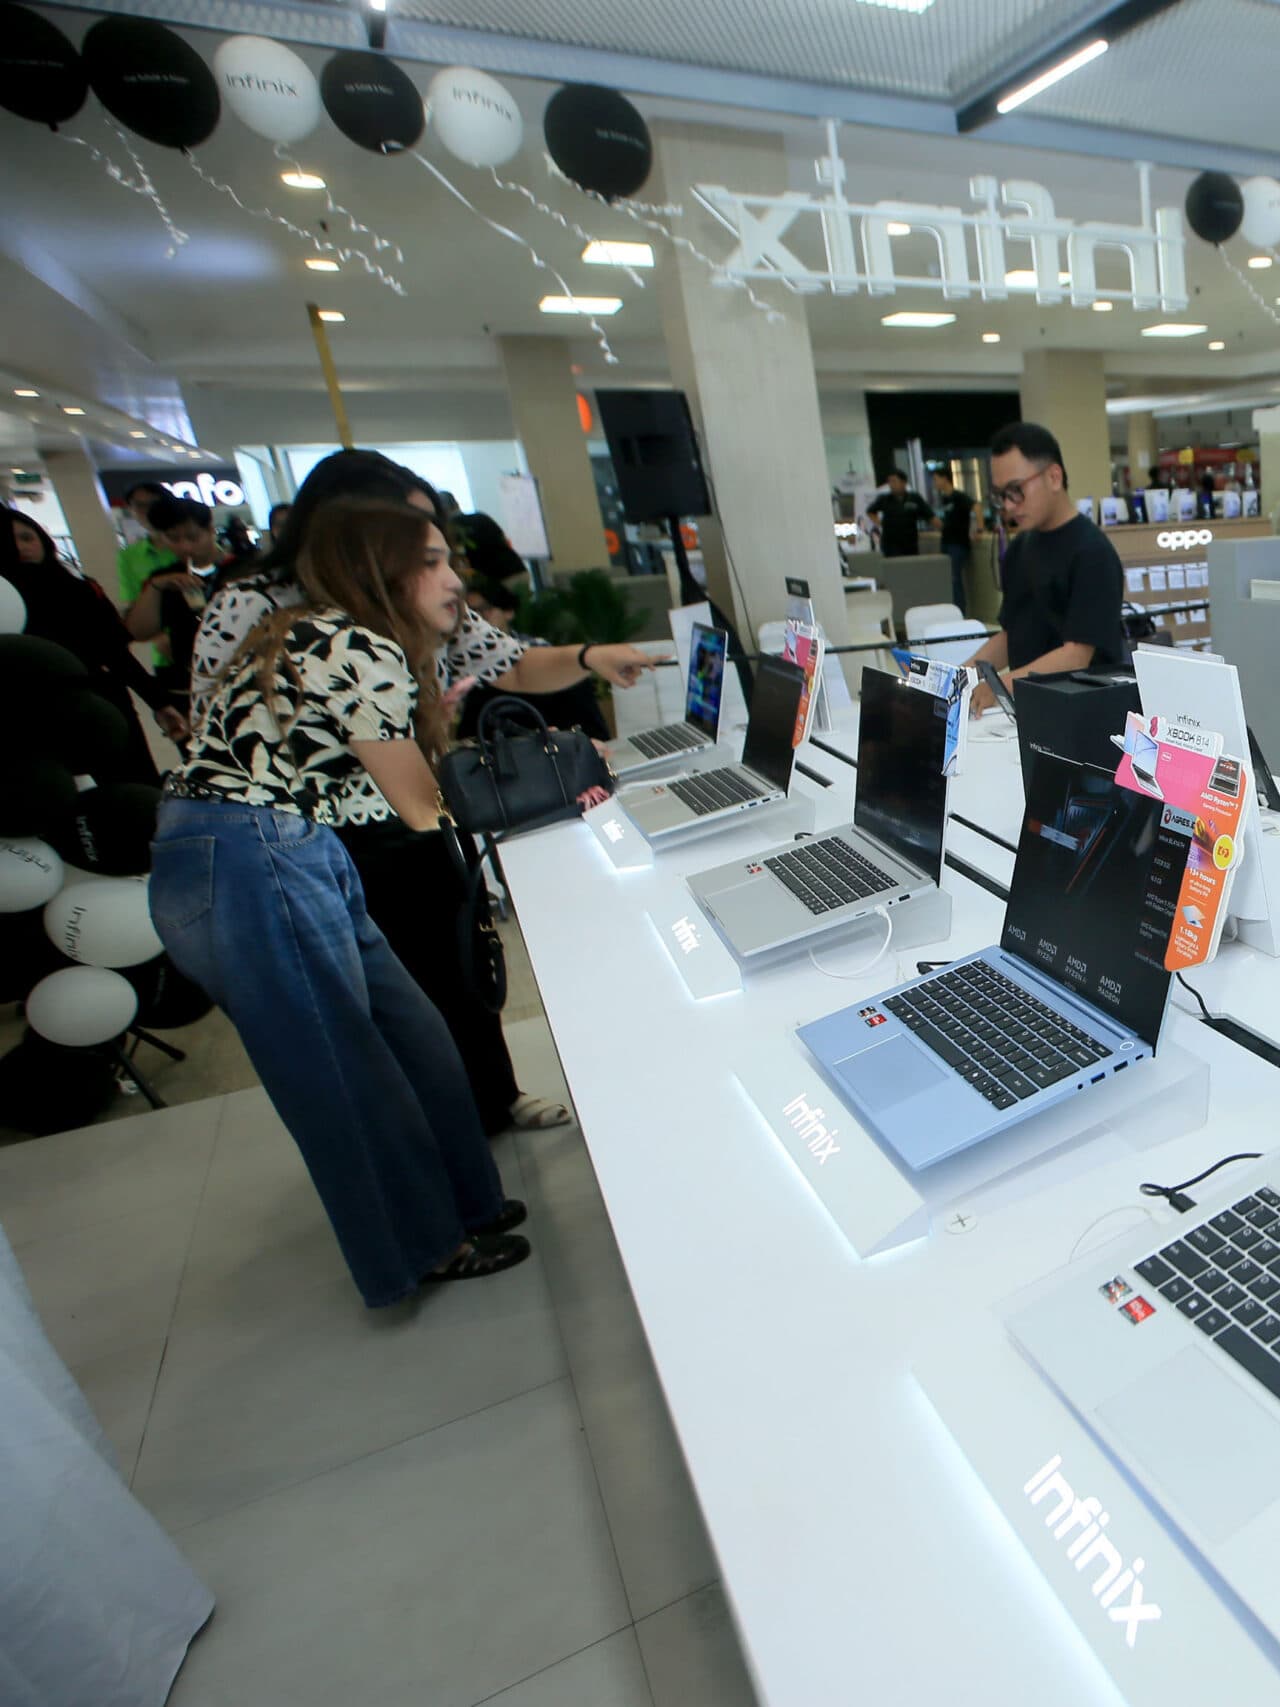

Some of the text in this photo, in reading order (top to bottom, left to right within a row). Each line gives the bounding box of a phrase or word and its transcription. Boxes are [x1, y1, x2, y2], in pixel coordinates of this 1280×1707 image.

[225, 73, 298, 97] Infinix
[1157, 529, 1213, 551] oppo
[782, 1093, 840, 1165] Infinix
[1023, 1454, 1161, 1648] Infinix
